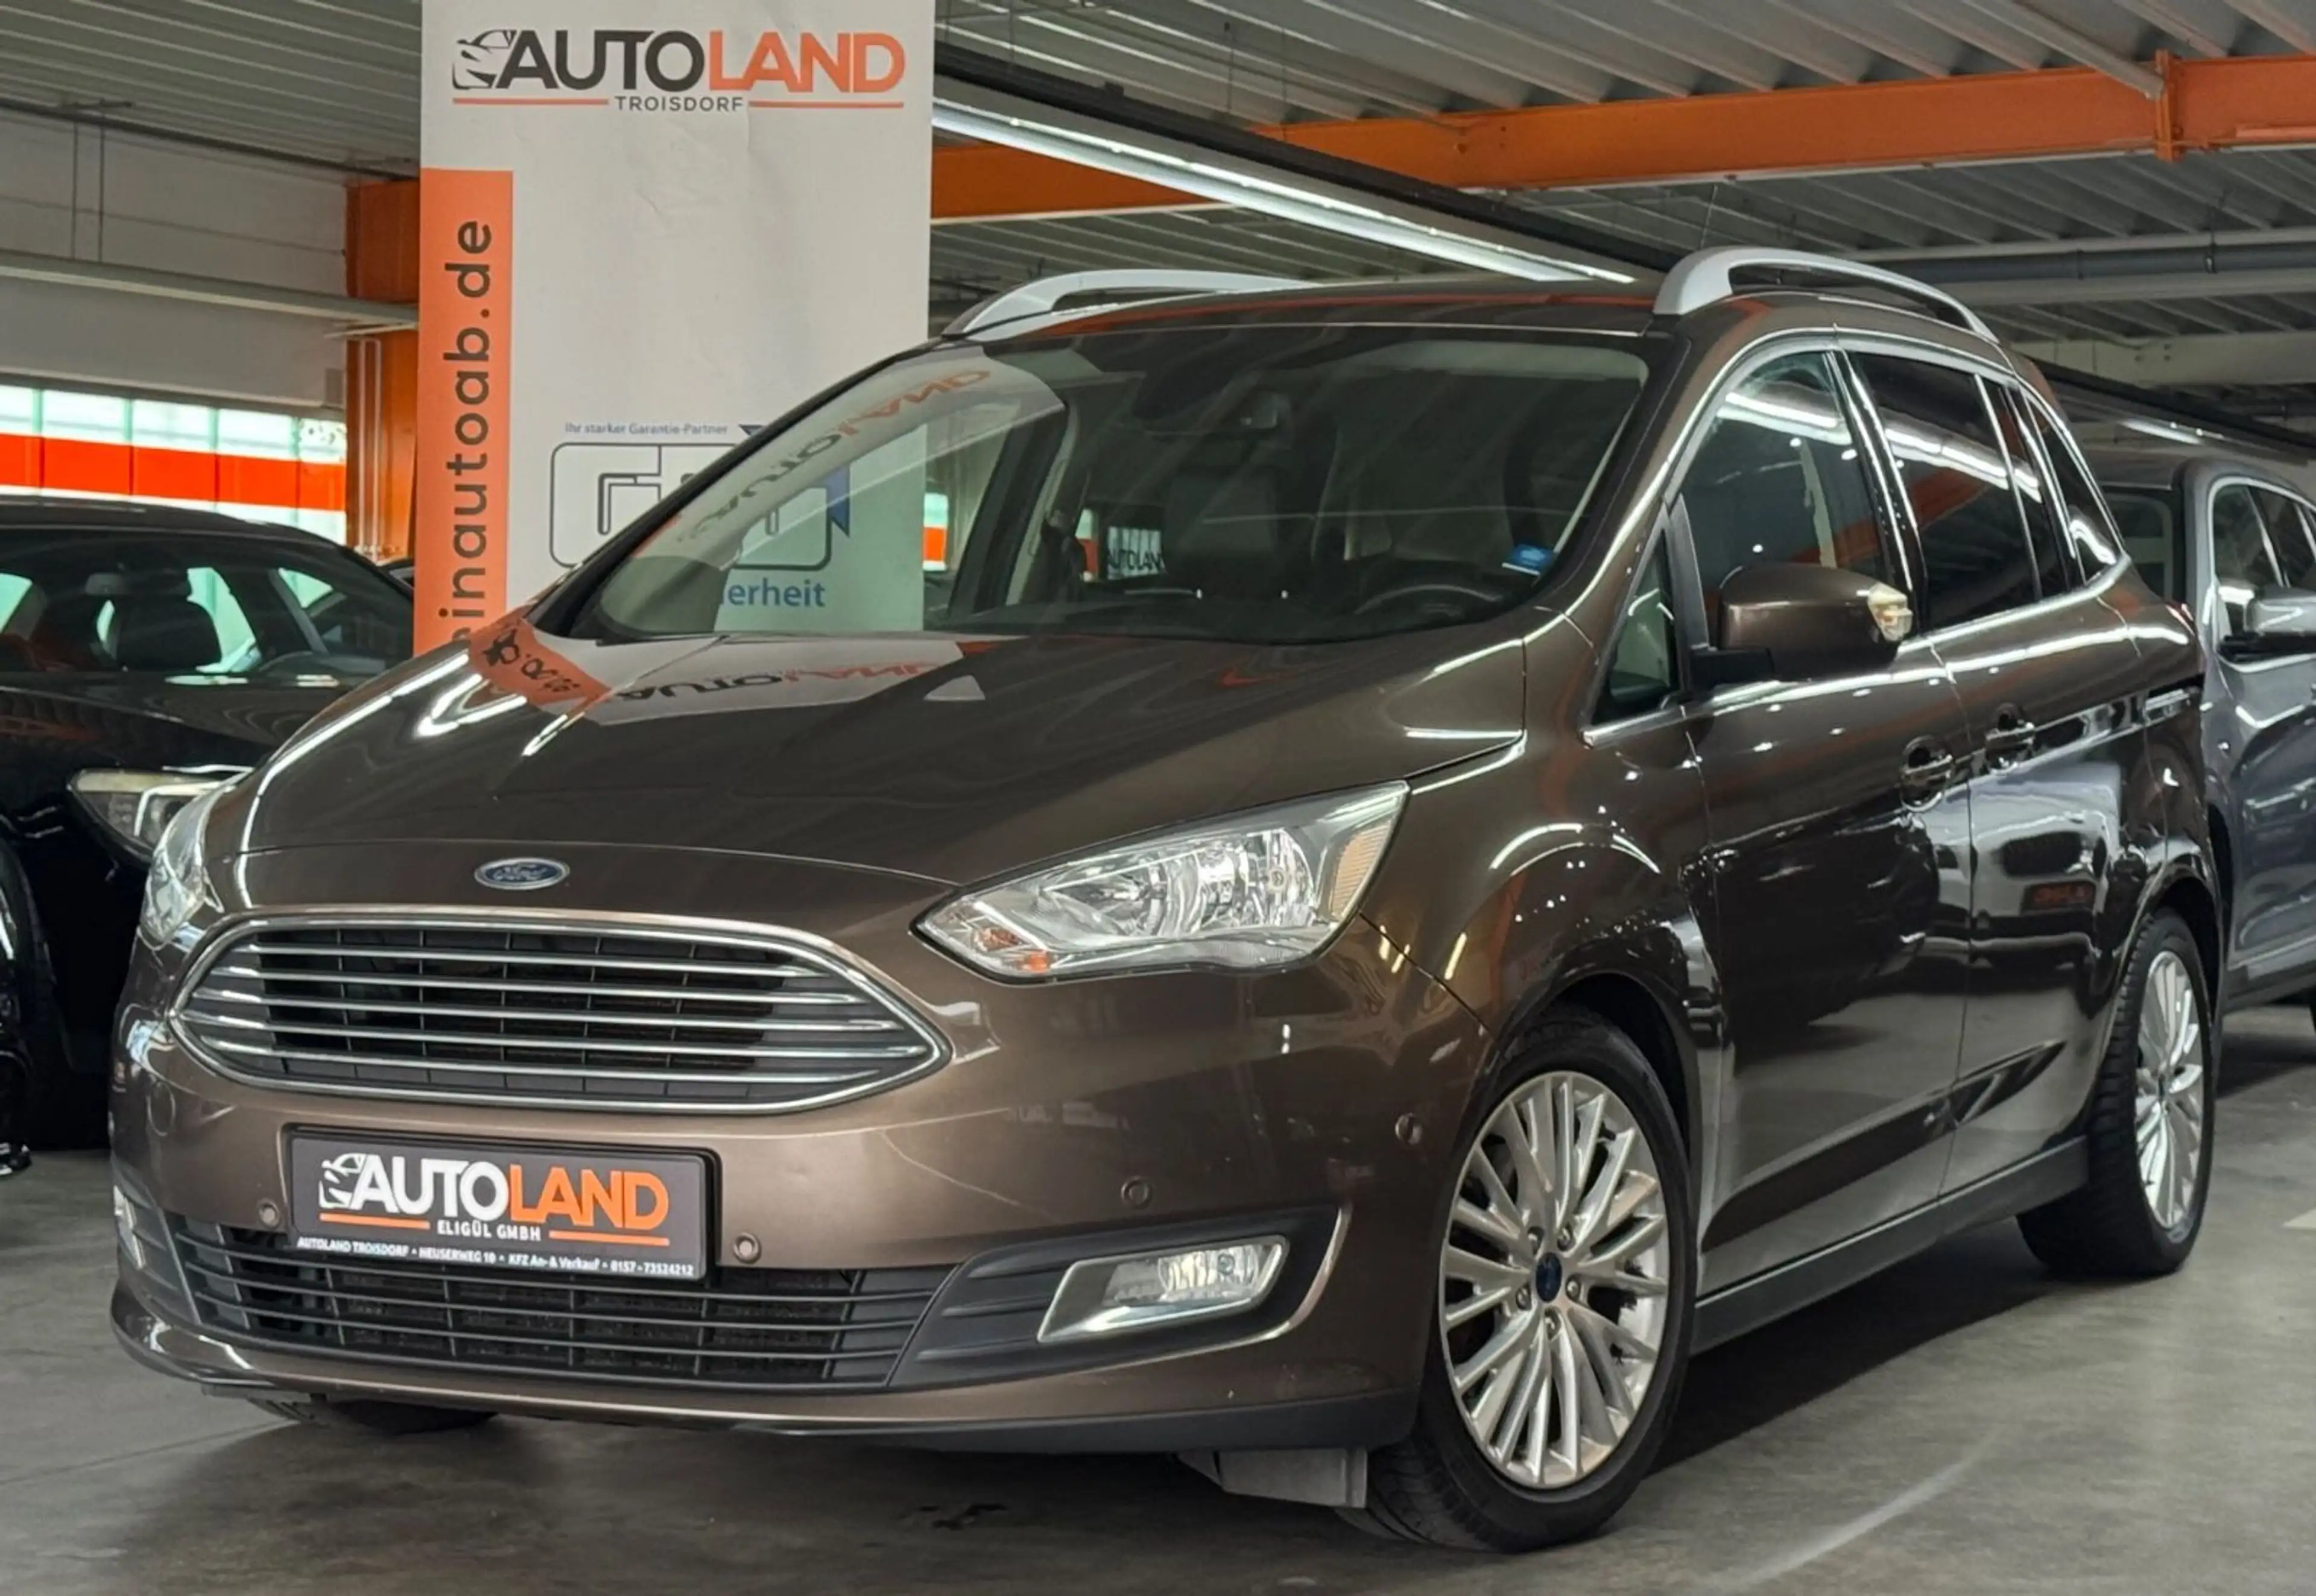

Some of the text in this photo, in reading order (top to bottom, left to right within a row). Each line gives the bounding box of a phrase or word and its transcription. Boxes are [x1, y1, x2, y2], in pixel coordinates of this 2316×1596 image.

[496, 30, 905, 93] AUTOLAND
[614, 95, 743, 112] TROISDORF
[565, 421, 728, 435] Ihr starker Garantie-Partner
[727, 576, 826, 608] erheit
[349, 1154, 669, 1231] AUTOLAND
[437, 1218, 542, 1241] ELIGÜL GMBH
[296, 1236, 351, 1253] AUTOLAND
[352, 1240, 409, 1257] TROISDORF
[483, 1252, 496, 1264] 10
[507, 1252, 530, 1265] KFZ
[558, 1256, 600, 1271] Verkauf
